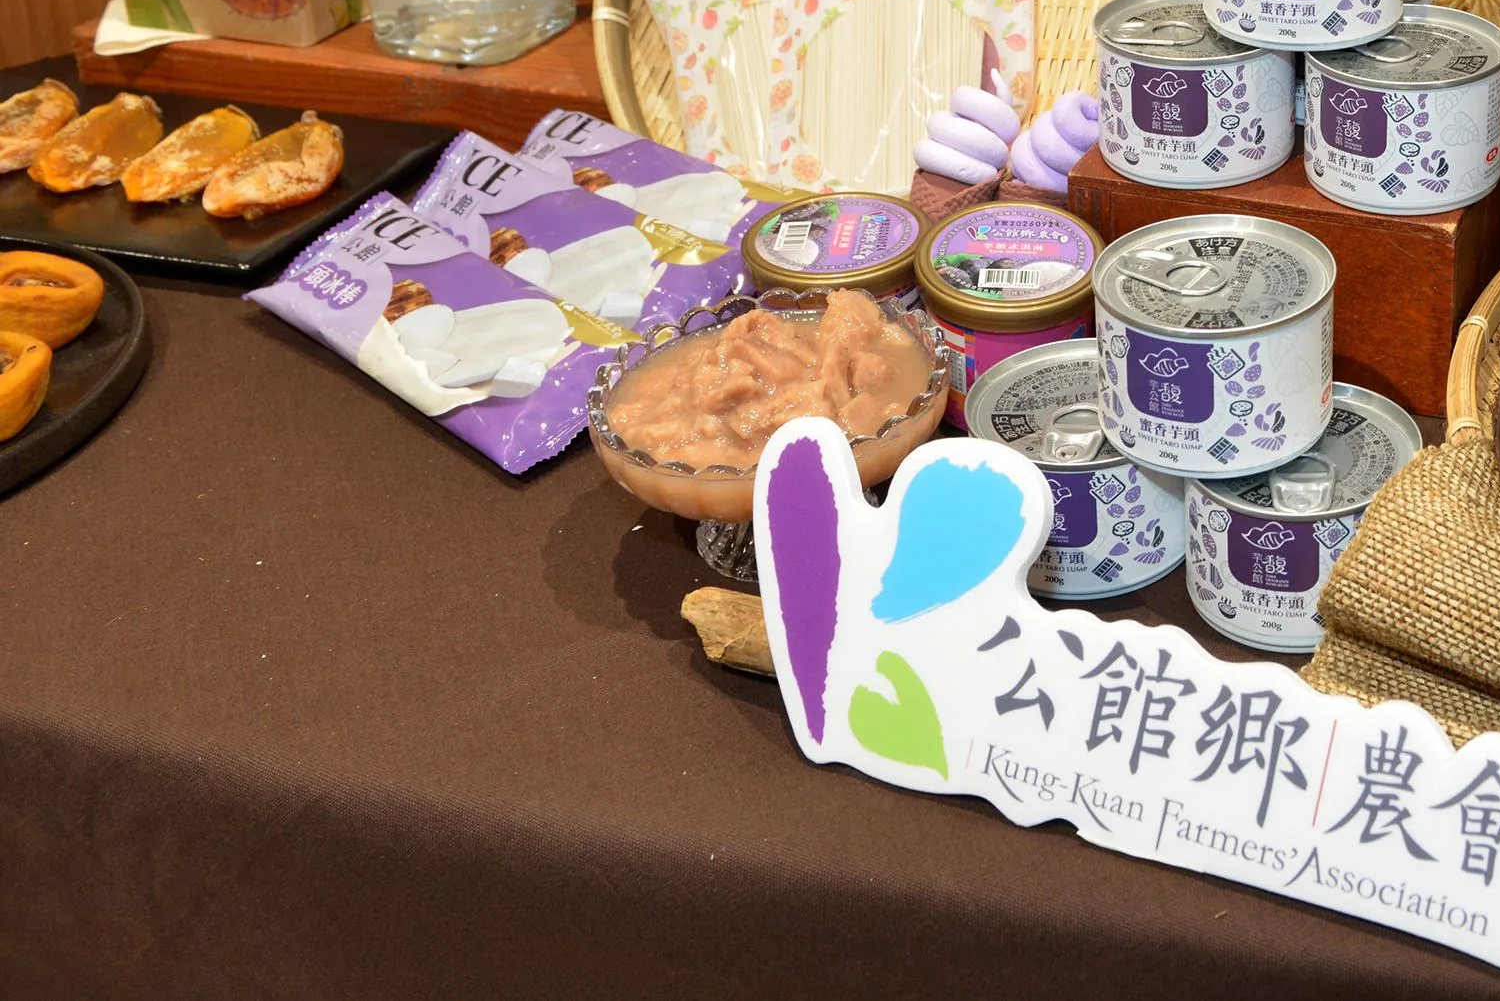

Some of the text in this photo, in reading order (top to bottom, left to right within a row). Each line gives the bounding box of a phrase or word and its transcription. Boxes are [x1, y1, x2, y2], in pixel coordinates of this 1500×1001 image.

[1260, 1, 1316, 17] 蜜香芋頭
[1258, 15, 1278, 24] SWEET
[1280, 17, 1298, 25] TARO
[1278, 28, 1297, 38] 200g
[1161, 102, 1182, 121] 馥
[1342, 119, 1361, 140] 馥
[1143, 136, 1197, 153] 蜜香芋頭
[1141, 149, 1160, 159] SWEET
[1161, 152, 1178, 160] TARO
[1327, 150, 1374, 175] 蜜香芋頭
[1160, 162, 1178, 173] 200g
[1340, 179, 1356, 192] 200g
[361, 208, 440, 251] ICE
[1195, 237, 1239, 248] あけ方
[1200, 246, 1232, 256] 注意
[1158, 382, 1183, 404] 馥
[1139, 417, 1200, 442] 蜜香芋頭
[1138, 432, 1202, 450] SWEET TARO LUMP
[1159, 449, 1179, 462] 200g
[1045, 565, 1065, 573] TARO
[1262, 554, 1288, 575] 馥
[1045, 575, 1065, 585] 200g
[1241, 588, 1304, 610] 蜜香芋頭
[1239, 602, 1261, 613] SWEET
[1263, 608, 1283, 618] TARO
[1261, 620, 1282, 631] 200g
[980, 743, 1144, 834] Kung-Kuan
[1283, 845, 1490, 938] Association
